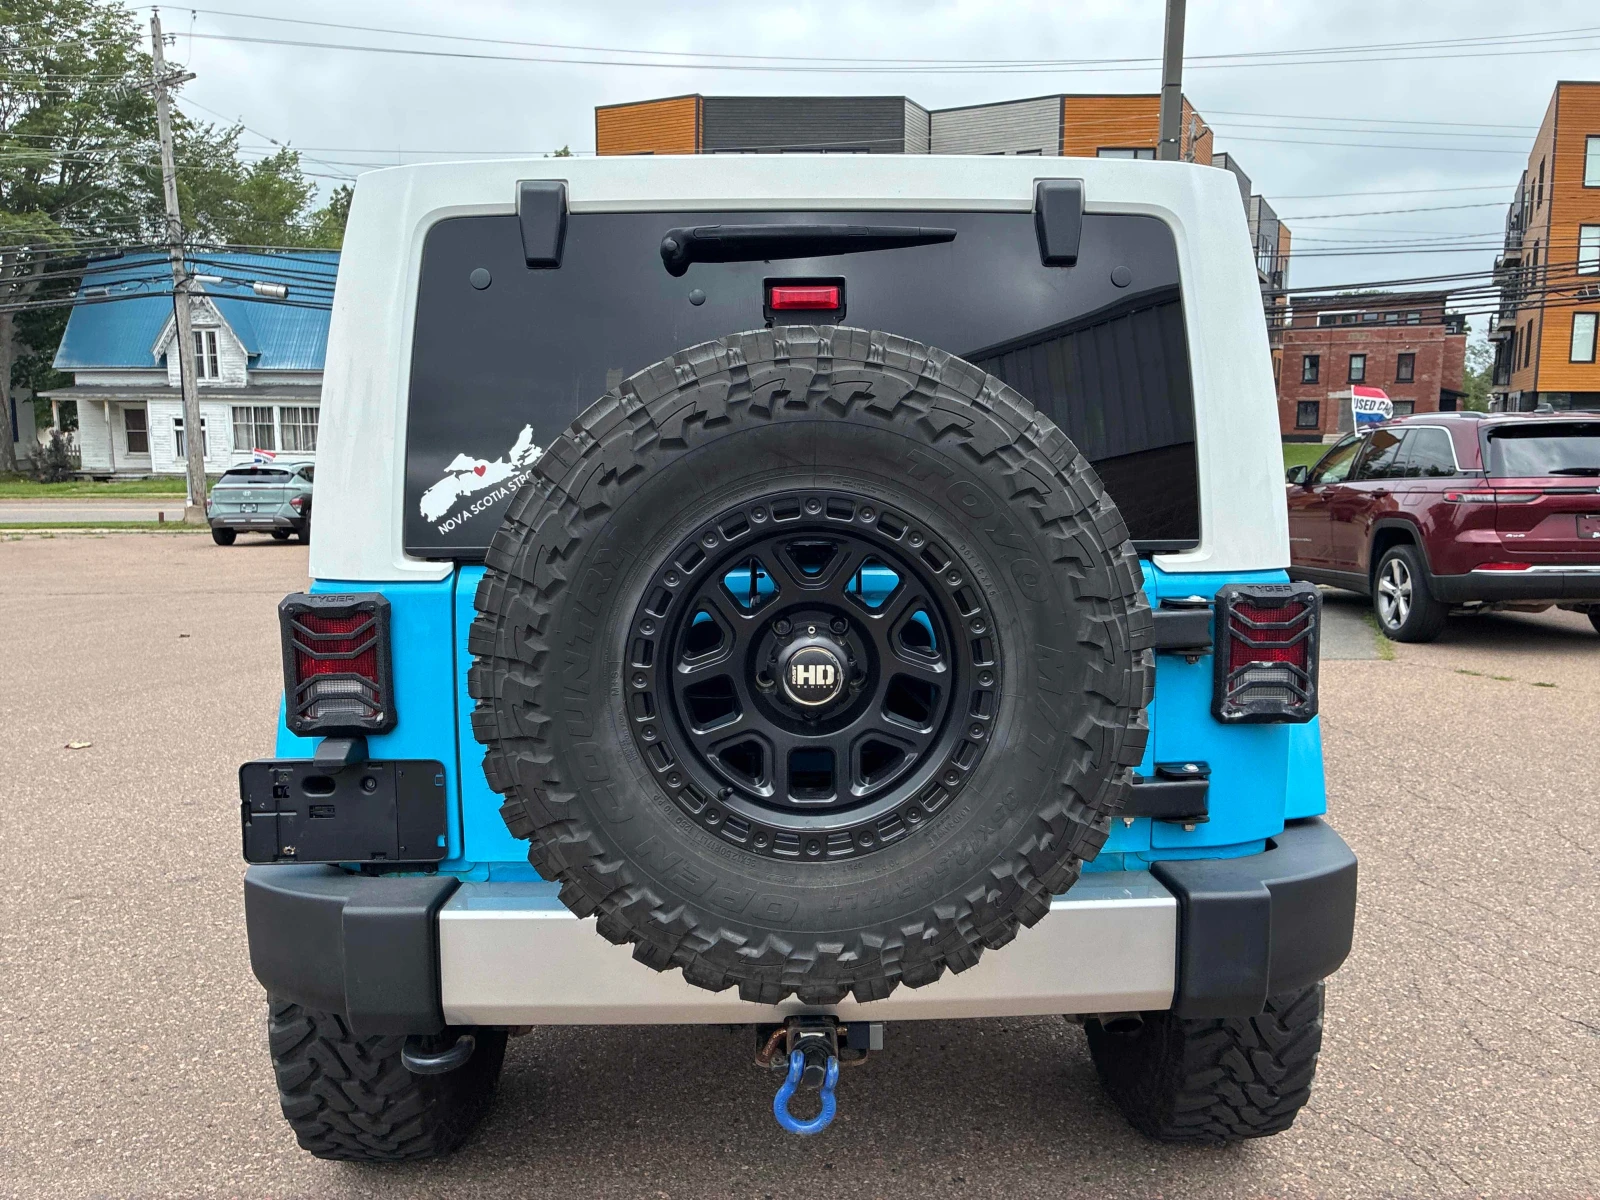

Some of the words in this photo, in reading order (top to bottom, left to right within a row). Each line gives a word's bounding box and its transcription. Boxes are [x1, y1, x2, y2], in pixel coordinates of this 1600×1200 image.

[1353, 398, 1376, 411] USED
[438, 510, 473, 535] NOVA
[470, 486, 510, 515] SCOTIA
[906, 449, 1049, 602] TOYO
[797, 665, 835, 685] HD
[635, 834, 799, 922] OPEN
